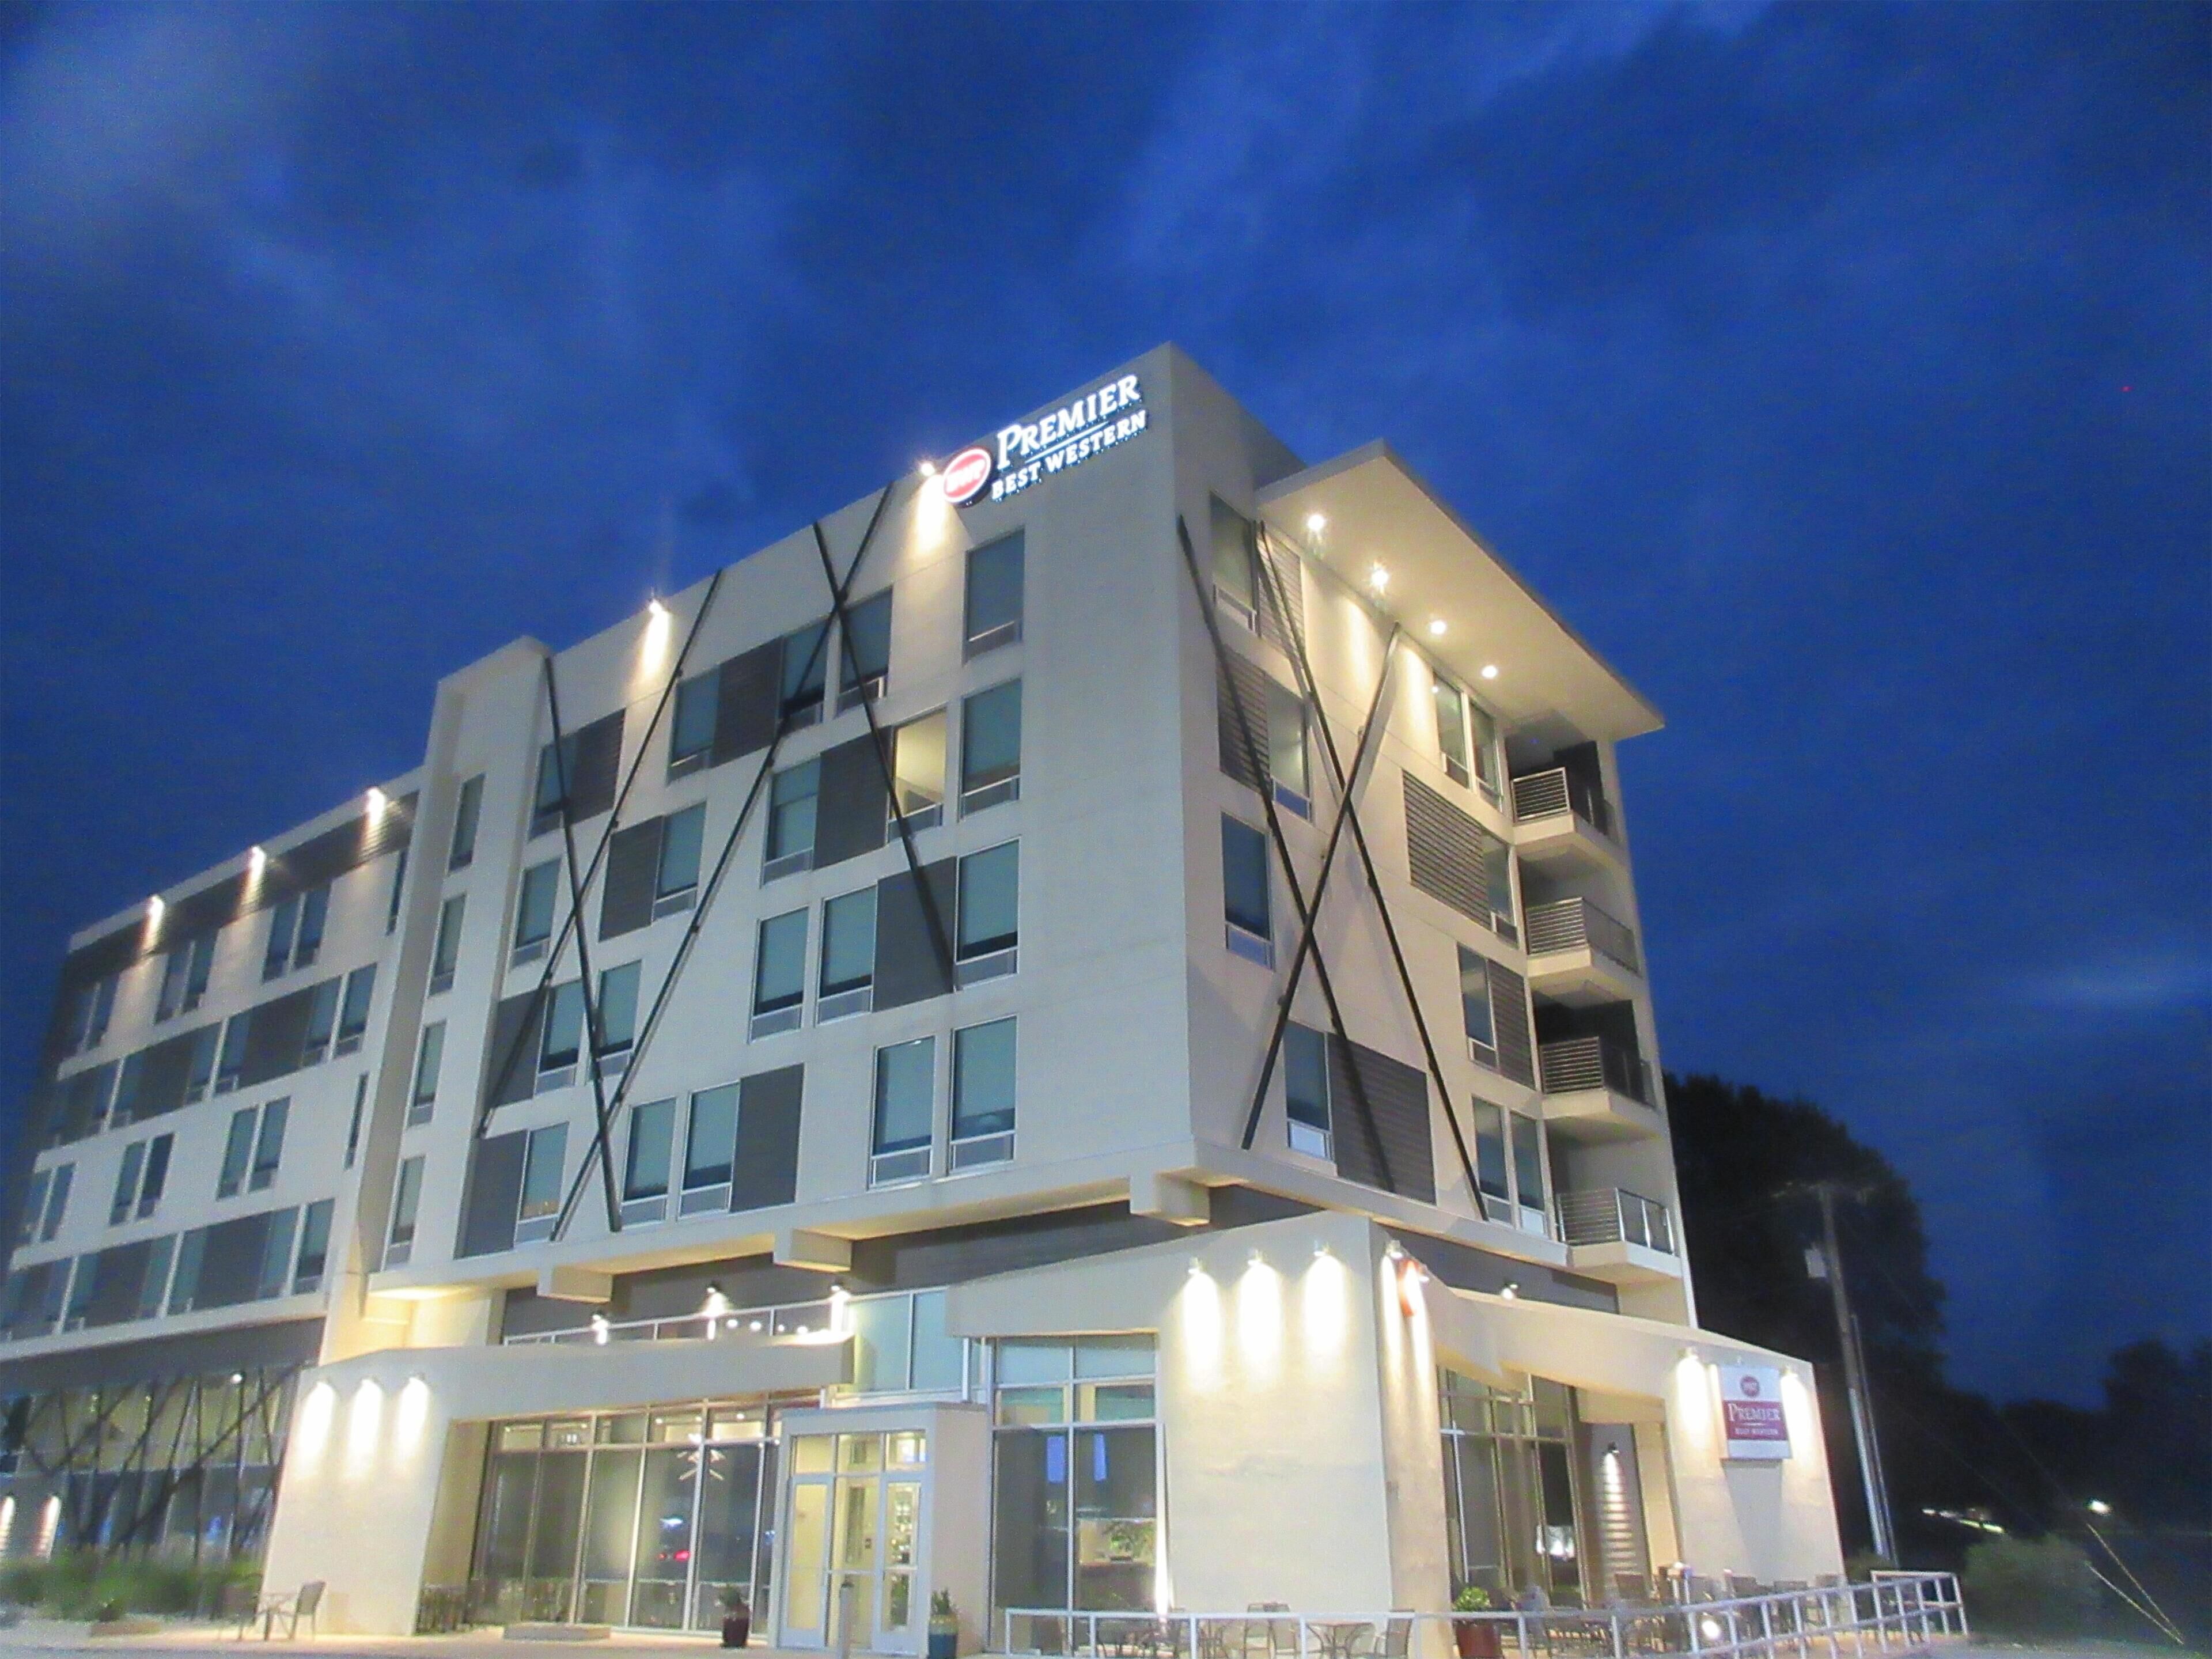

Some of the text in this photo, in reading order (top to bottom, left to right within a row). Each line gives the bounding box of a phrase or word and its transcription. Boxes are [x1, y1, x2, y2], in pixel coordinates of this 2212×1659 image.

[991, 461, 1041, 500] BEST
[1044, 410, 1147, 472] WESTERN
[996, 374, 1141, 471] PREMIER
[1728, 1403, 1781, 1422] PREMIER
